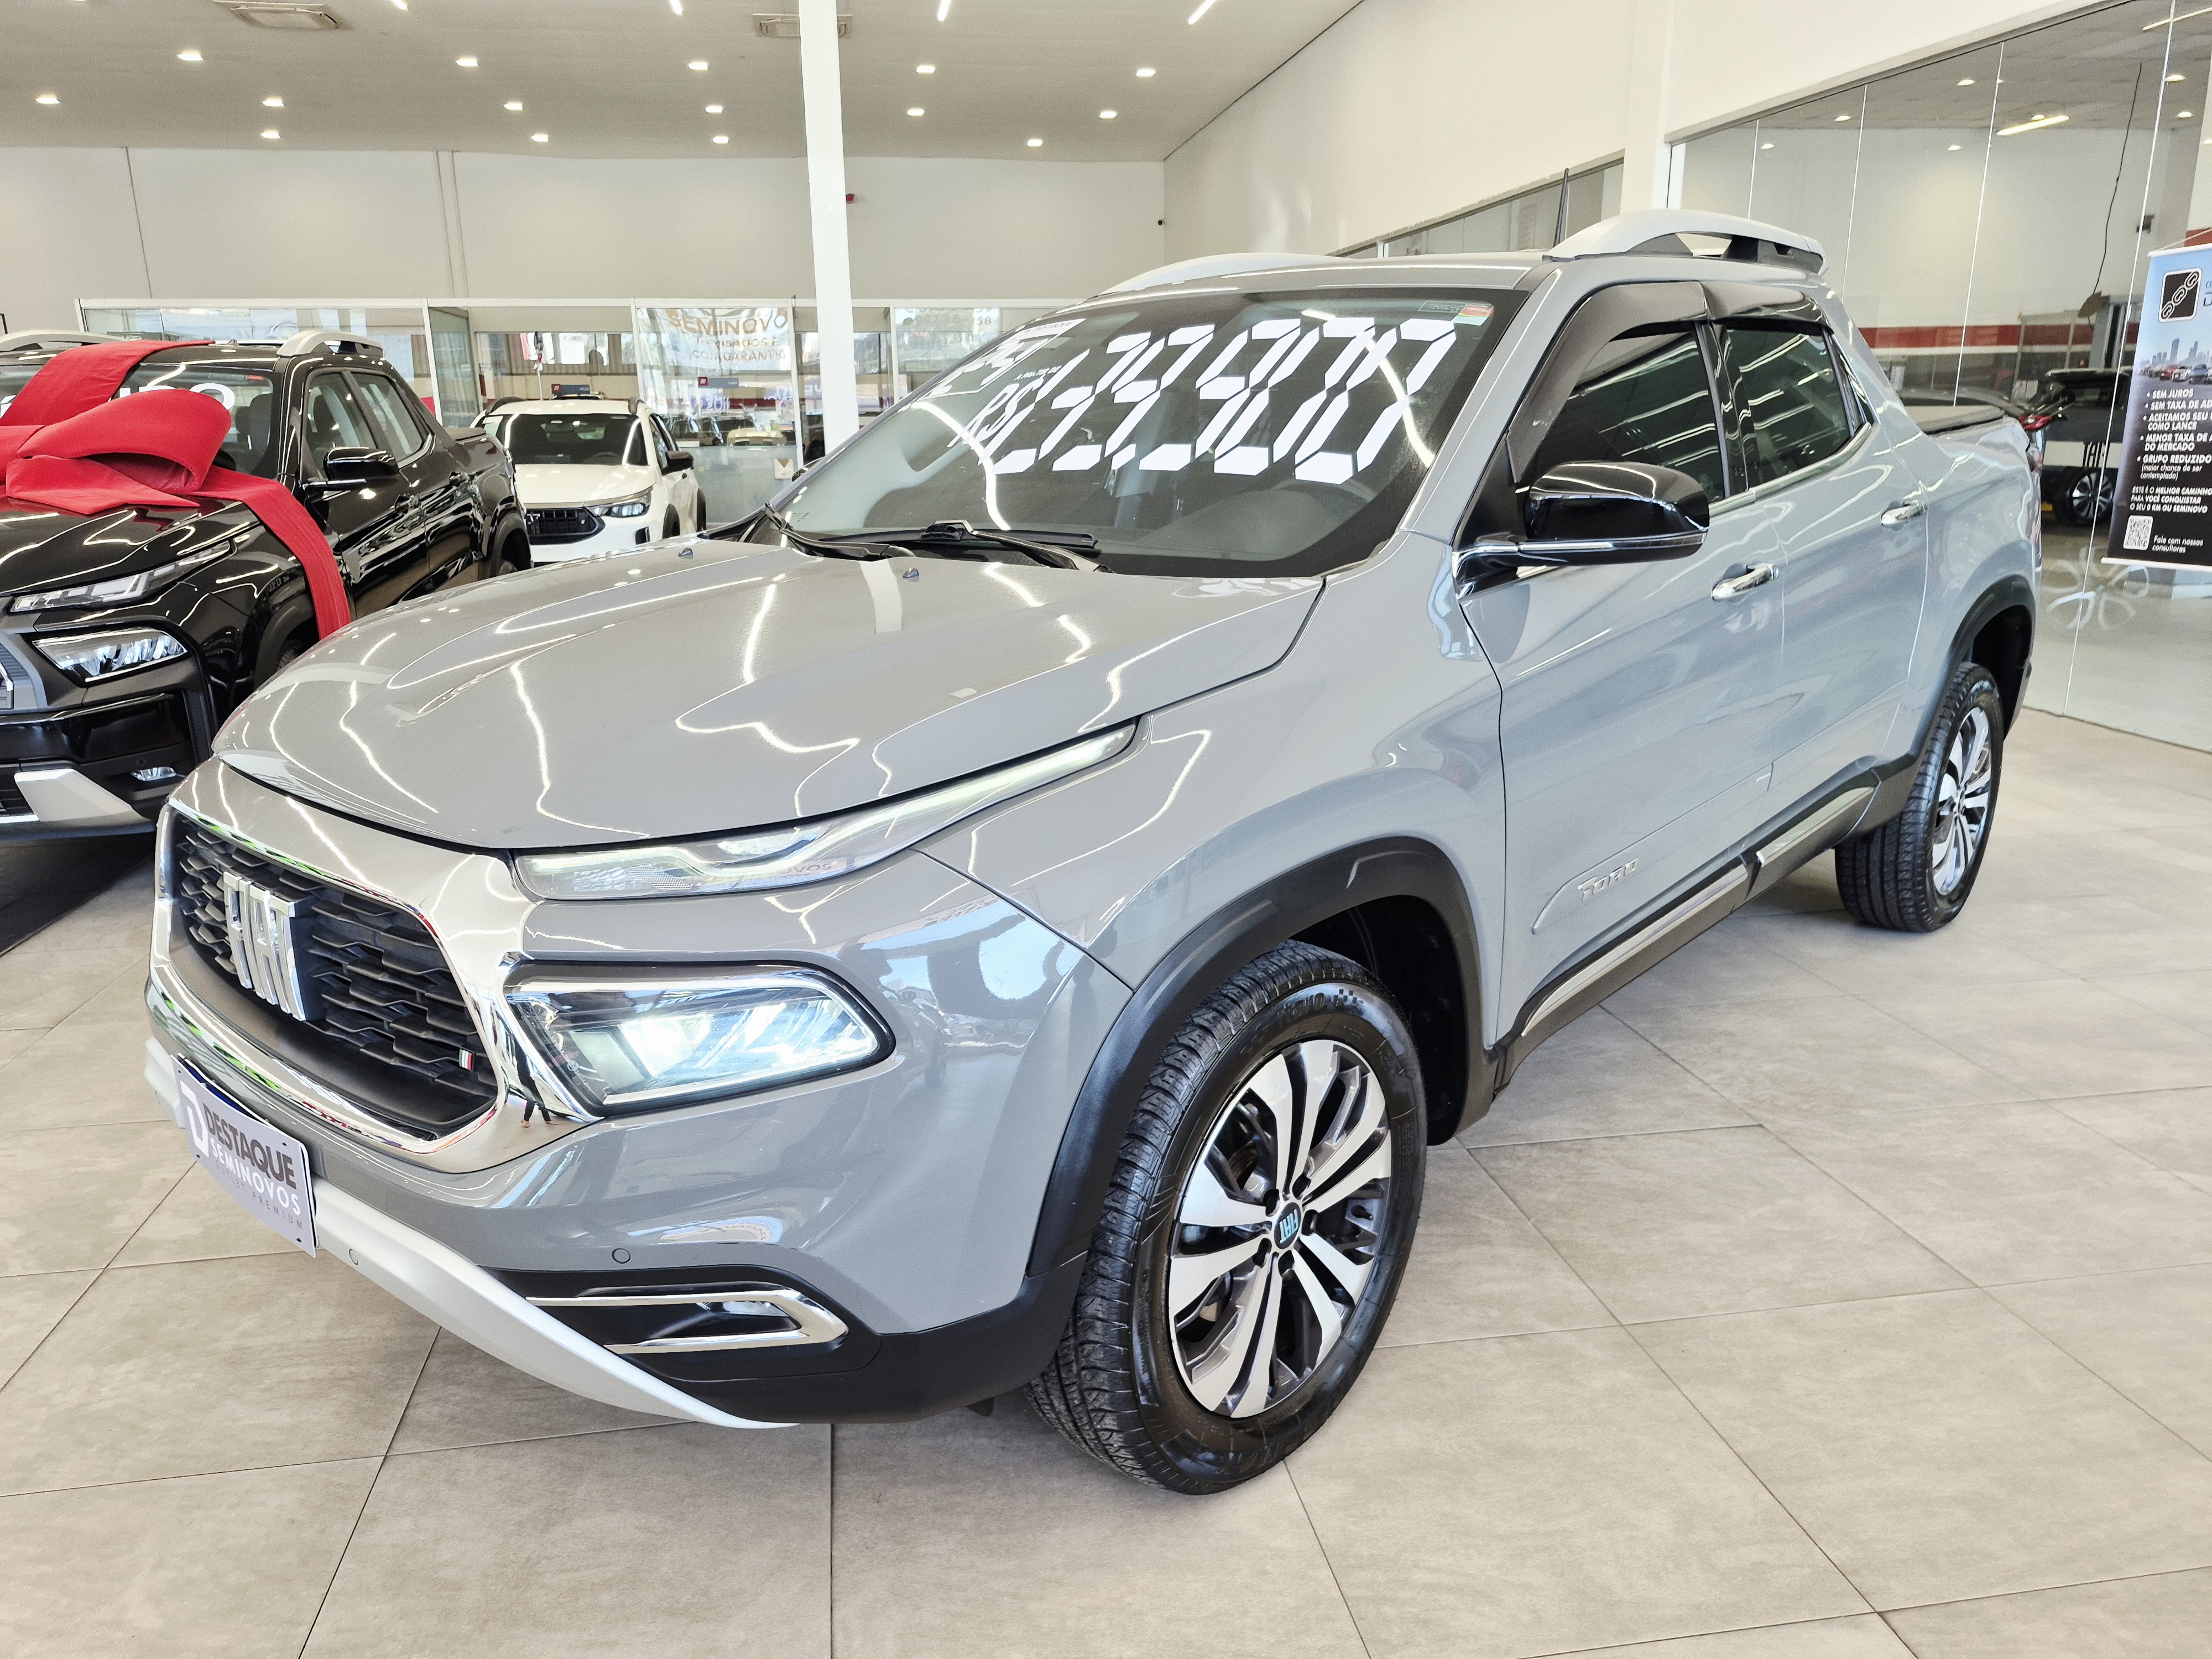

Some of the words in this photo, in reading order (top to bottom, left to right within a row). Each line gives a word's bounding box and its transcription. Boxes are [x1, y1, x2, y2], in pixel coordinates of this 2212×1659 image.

[1047, 366, 1062, 374] DE
[2152, 389, 2167, 399] SEM
[2168, 388, 2194, 398] JUROS
[2150, 400, 2166, 410] SEM
[2167, 400, 2187, 409] TAXA
[2188, 400, 2200, 409] DE
[2148, 412, 2190, 422] ACEITAMOS
[2192, 411, 2209, 421] SEU
[2147, 421, 2171, 431] COMO
[2171, 421, 2198, 430] LANCE
[2146, 432, 2173, 442] MENOR
[2174, 432, 2195, 442] TAXA
[2196, 432, 2208, 442] DE
[2145, 442, 2156, 451] DO
[2157, 442, 2195, 451] MERCADO
[2143, 454, 2168, 464] GRUPO
[2170, 454, 2212, 464] REDUZIDO
[2141, 463, 2159, 472] (maior
[2160, 463, 2182, 472] chance
[2182, 463, 2191, 472] de
[2140, 472, 2178, 481] contemplado)
[2132, 486, 2145, 494] ESTE
[2155, 486, 2180, 495] MELHOR
[2181, 487, 2212, 495] CAMINHO
[2131, 494, 2144, 502] PARA
[2145, 493, 2160, 503] VOCÊ
[2161, 495, 2201, 504] CONQUISTAR
[2136, 503, 2146, 511] SEU
[2173, 504, 2208, 513] SEMINOVO
[2153, 535, 2167, 544] Fale
[2182, 538, 2204, 546] nossos
[2152, 544, 2186, 553] consultores
[224, 871, 306, 1021] FIAT
[202, 1102, 297, 1190] DESTAQUE
[210, 1138, 301, 1215] SEMINOVOS
[252, 1191, 303, 1230] PREMIUM
[1279, 1208, 1299, 1244] FIAT
